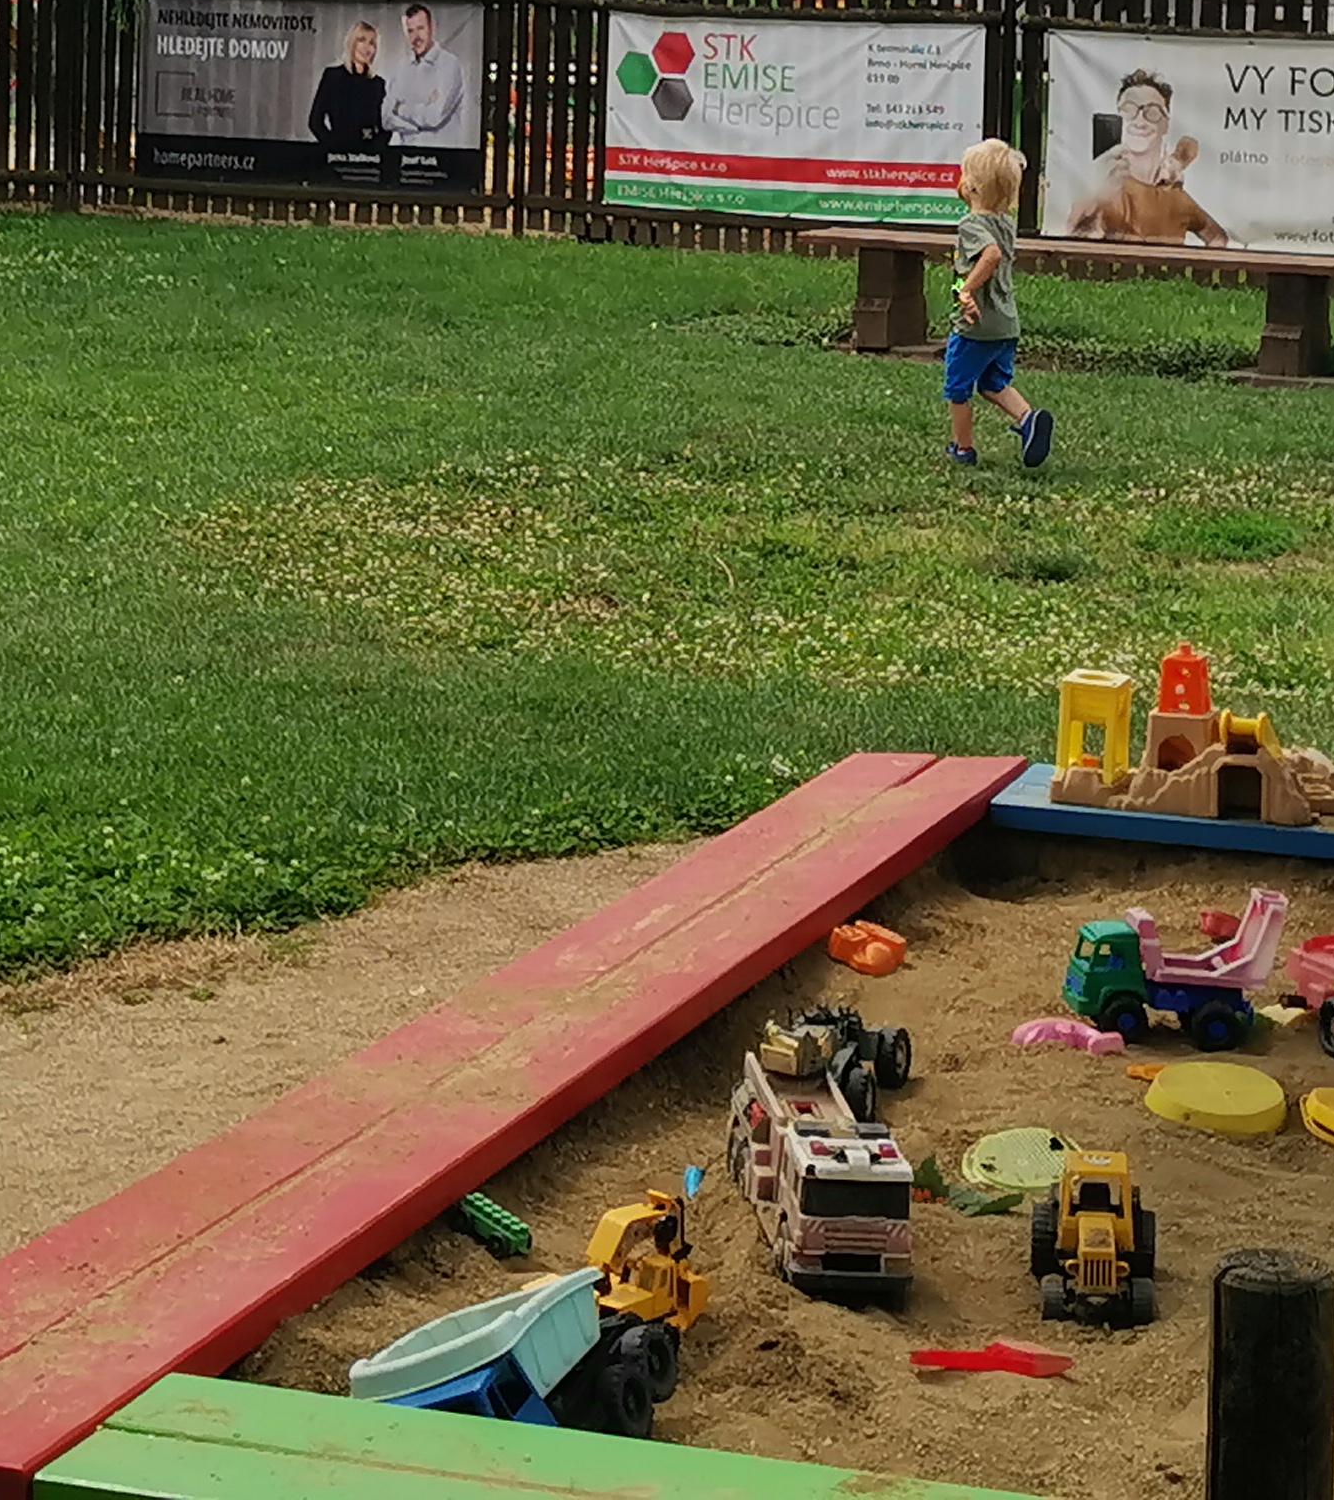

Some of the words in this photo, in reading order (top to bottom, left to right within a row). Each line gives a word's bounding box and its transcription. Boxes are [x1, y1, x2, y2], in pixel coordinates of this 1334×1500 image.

[157, 9, 230, 31] NEHLEDEJTE
[156, 34, 225, 62] HLEDEJTE
[228, 38, 290, 61] DOMOV
[703, 32, 757, 62] STK
[704, 62, 796, 93] EMISE
[1225, 62, 1275, 95] VY
[702, 92, 840, 136] Heršpice
[1223, 106, 1268, 131] MY
[1219, 150, 1269, 165] plátno
